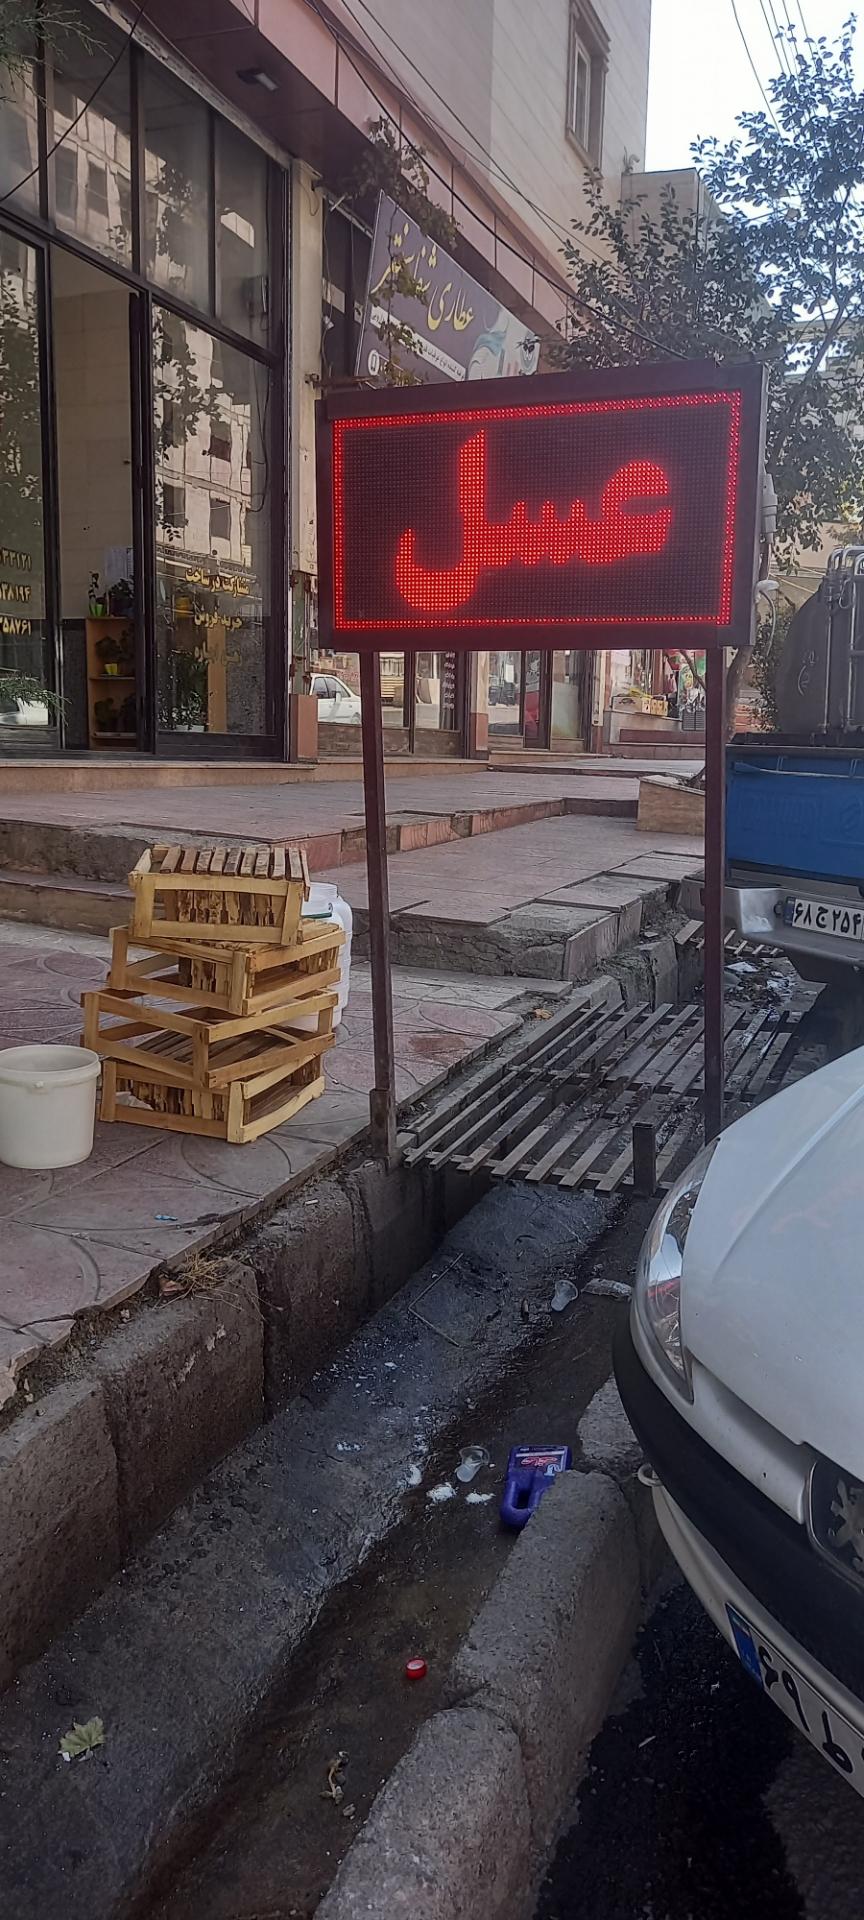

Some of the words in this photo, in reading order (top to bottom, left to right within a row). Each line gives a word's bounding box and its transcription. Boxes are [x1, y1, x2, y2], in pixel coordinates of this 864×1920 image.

[427, 281, 476, 331] عطاری
[395, 429, 672, 612] عسل
[185, 566, 210, 587] ساخت
[210, 574, 221, 593] در
[222, 574, 250, 598] مشارکت
